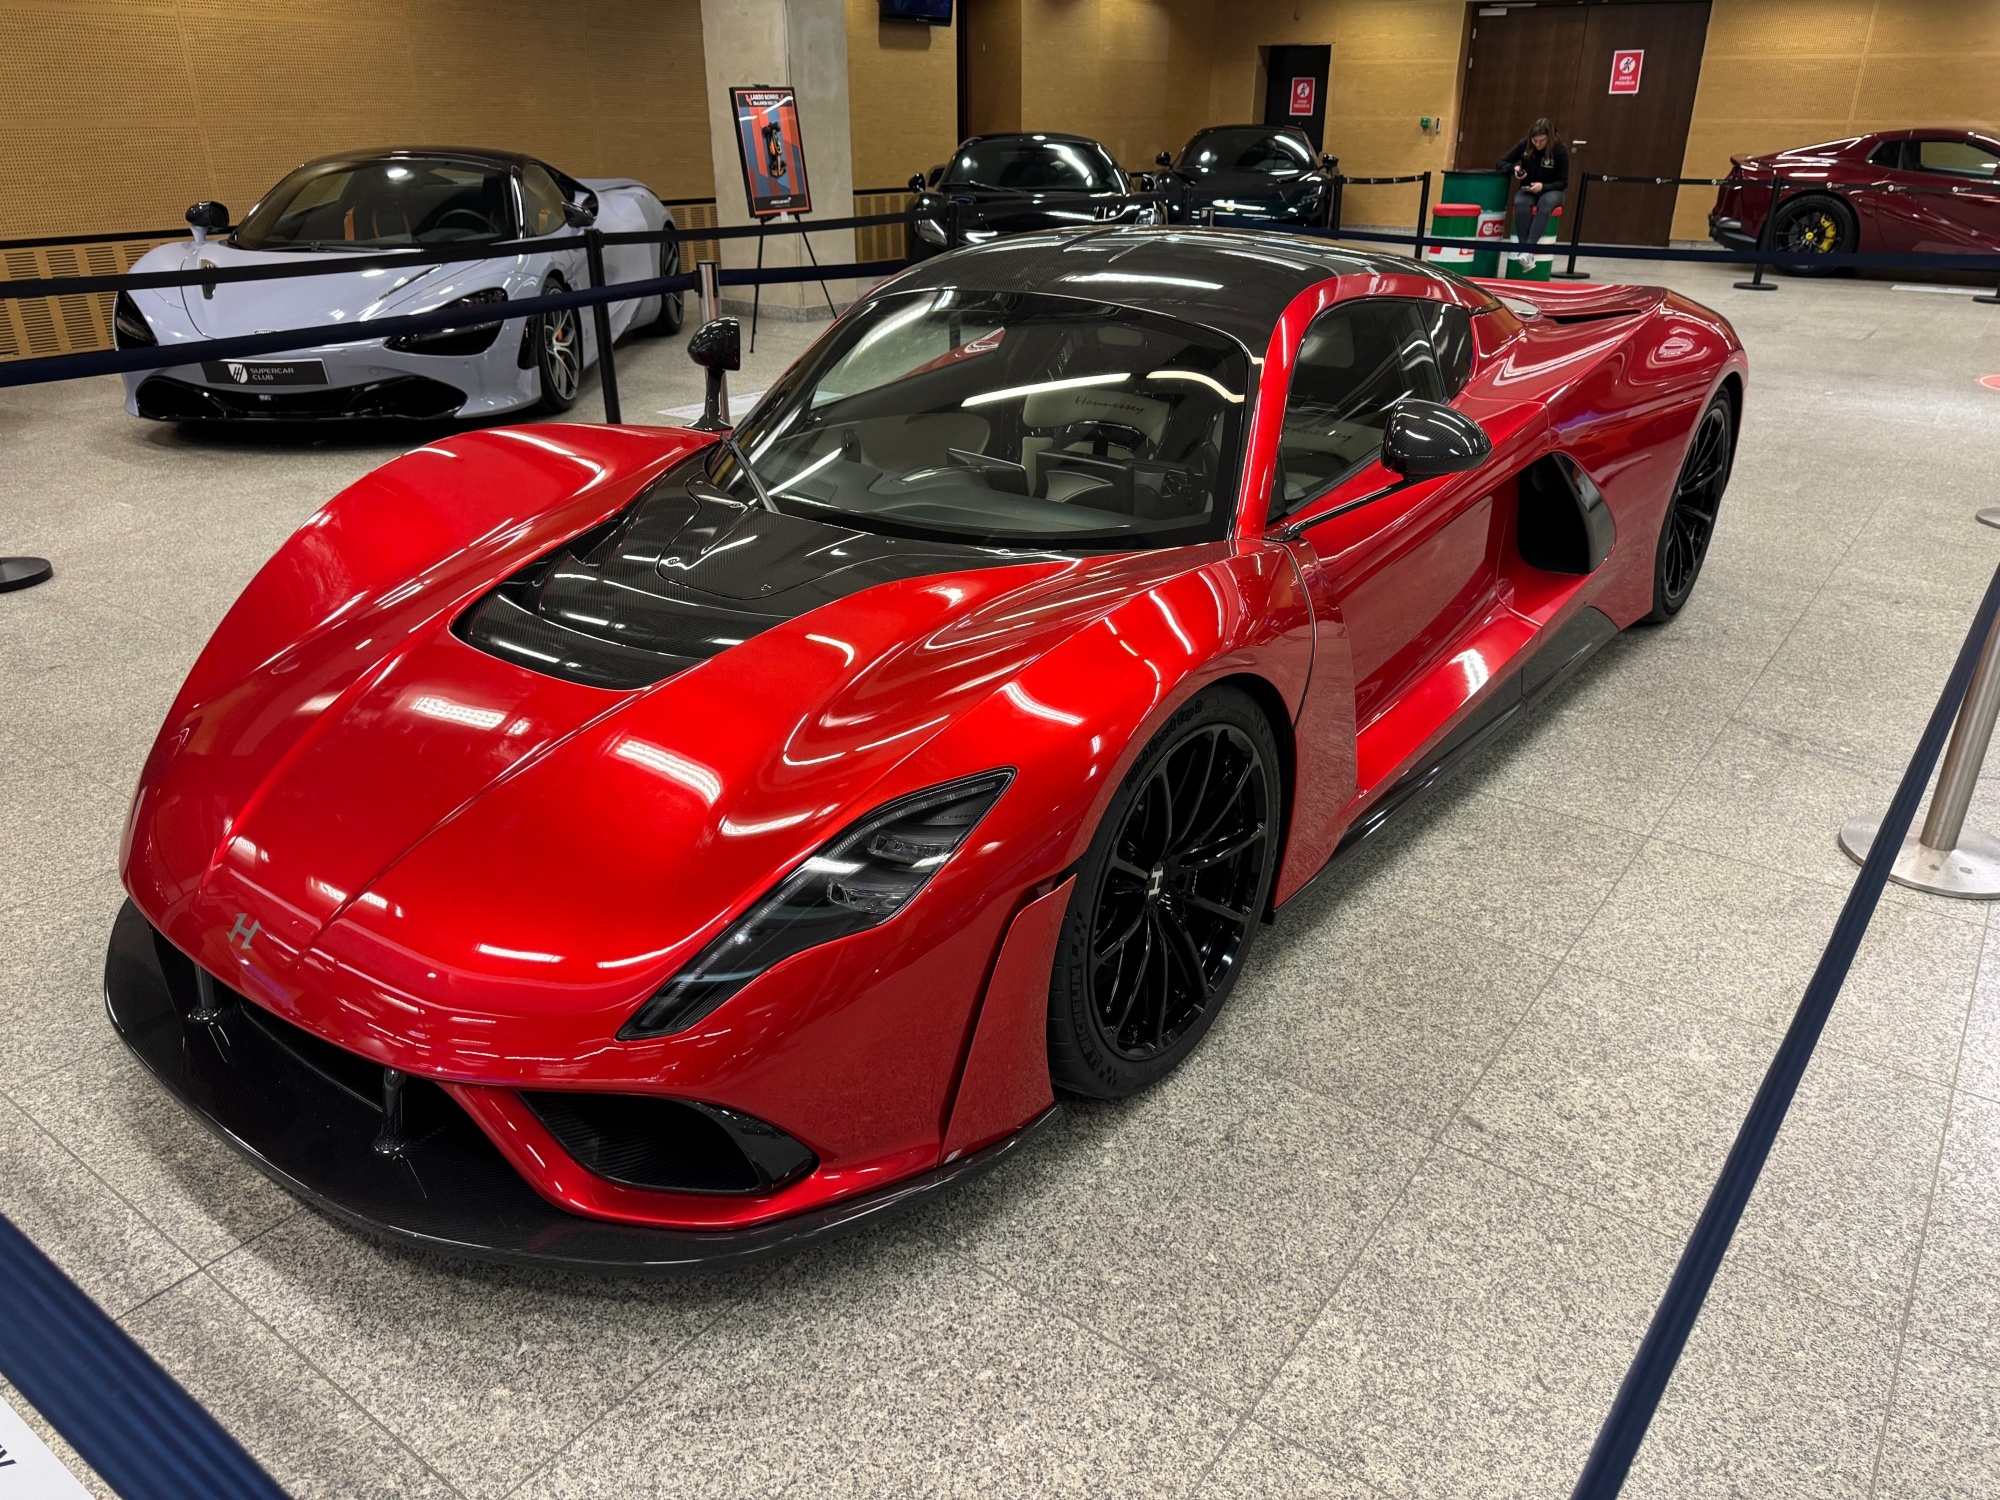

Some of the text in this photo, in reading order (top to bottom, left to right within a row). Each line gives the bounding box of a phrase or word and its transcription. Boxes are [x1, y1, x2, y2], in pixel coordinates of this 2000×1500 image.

[1075, 395, 1145, 415] Hennessey
[1284, 425, 1354, 443] ennesey
[1125, 699, 1203, 792] Pilot Sport Cup 2
[226, 912, 262, 950] H
[1071, 967, 1096, 1056] MICHELIN
